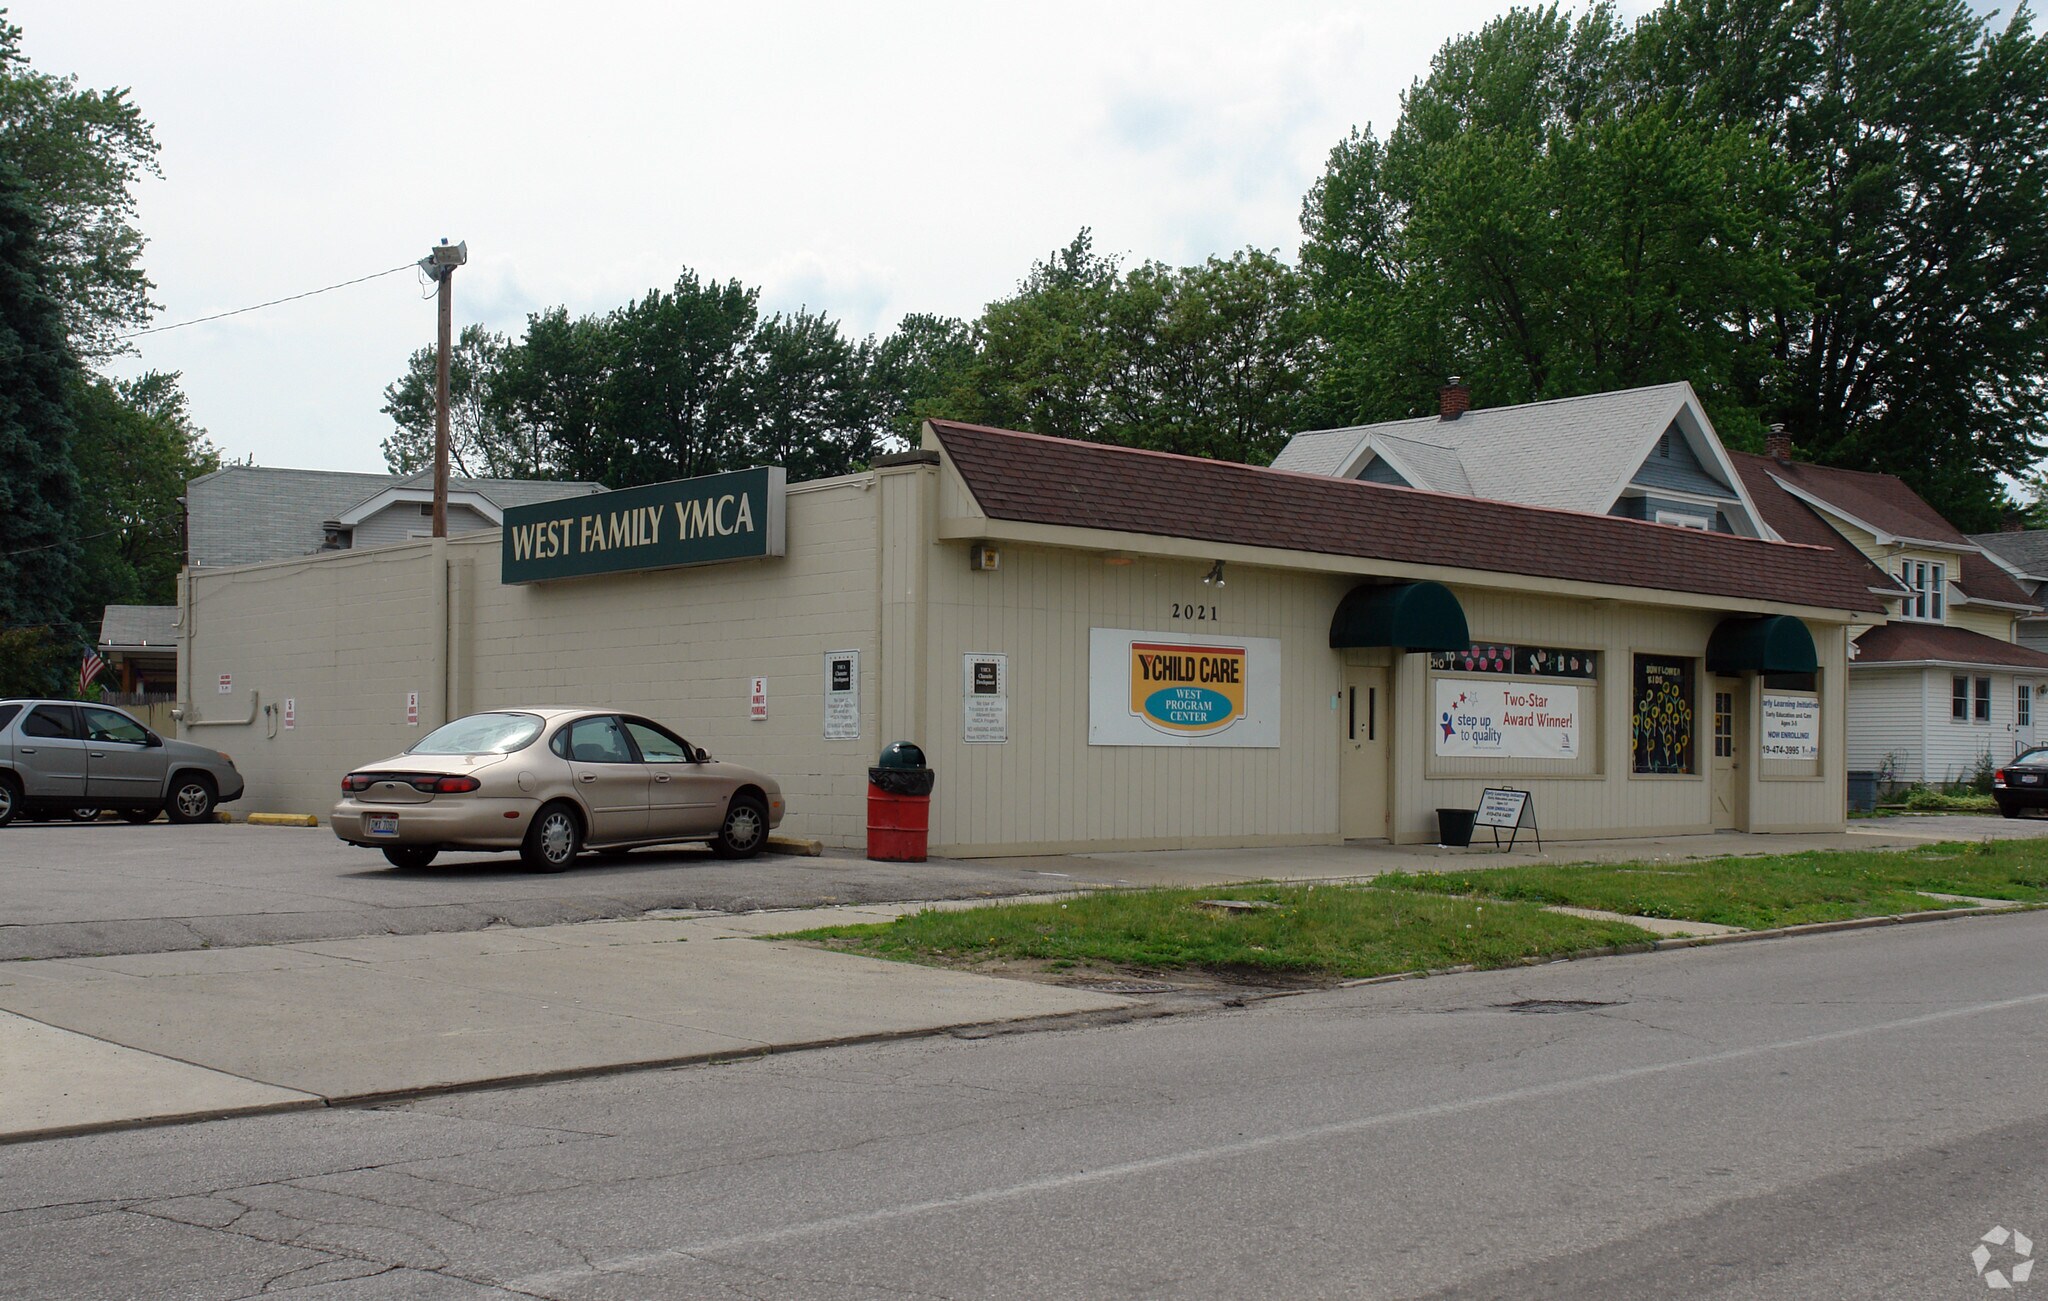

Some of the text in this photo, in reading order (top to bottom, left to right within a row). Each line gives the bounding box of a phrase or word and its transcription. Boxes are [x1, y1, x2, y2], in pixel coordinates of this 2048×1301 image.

[512, 492, 755, 561] WEST FAMILY YMCA
[1171, 603, 1218, 621] 2021
[1199, 656, 1239, 684] CARE
[755, 680, 762, 693] 5
[1176, 688, 1203, 700] WEST
[1503, 691, 1548, 708] Two-Star
[1165, 699, 1212, 711] PROGRAM
[1762, 699, 1772, 708] arly
[1773, 699, 1796, 709] Learning
[1170, 711, 1208, 722] CENTER
[1457, 714, 1491, 730] step up
[1503, 711, 1573, 729] Award Winner!
[1460, 728, 1502, 745] to quality
[1767, 731, 1780, 739] NOW
[1762, 744, 1800, 755] 19-474-3995
